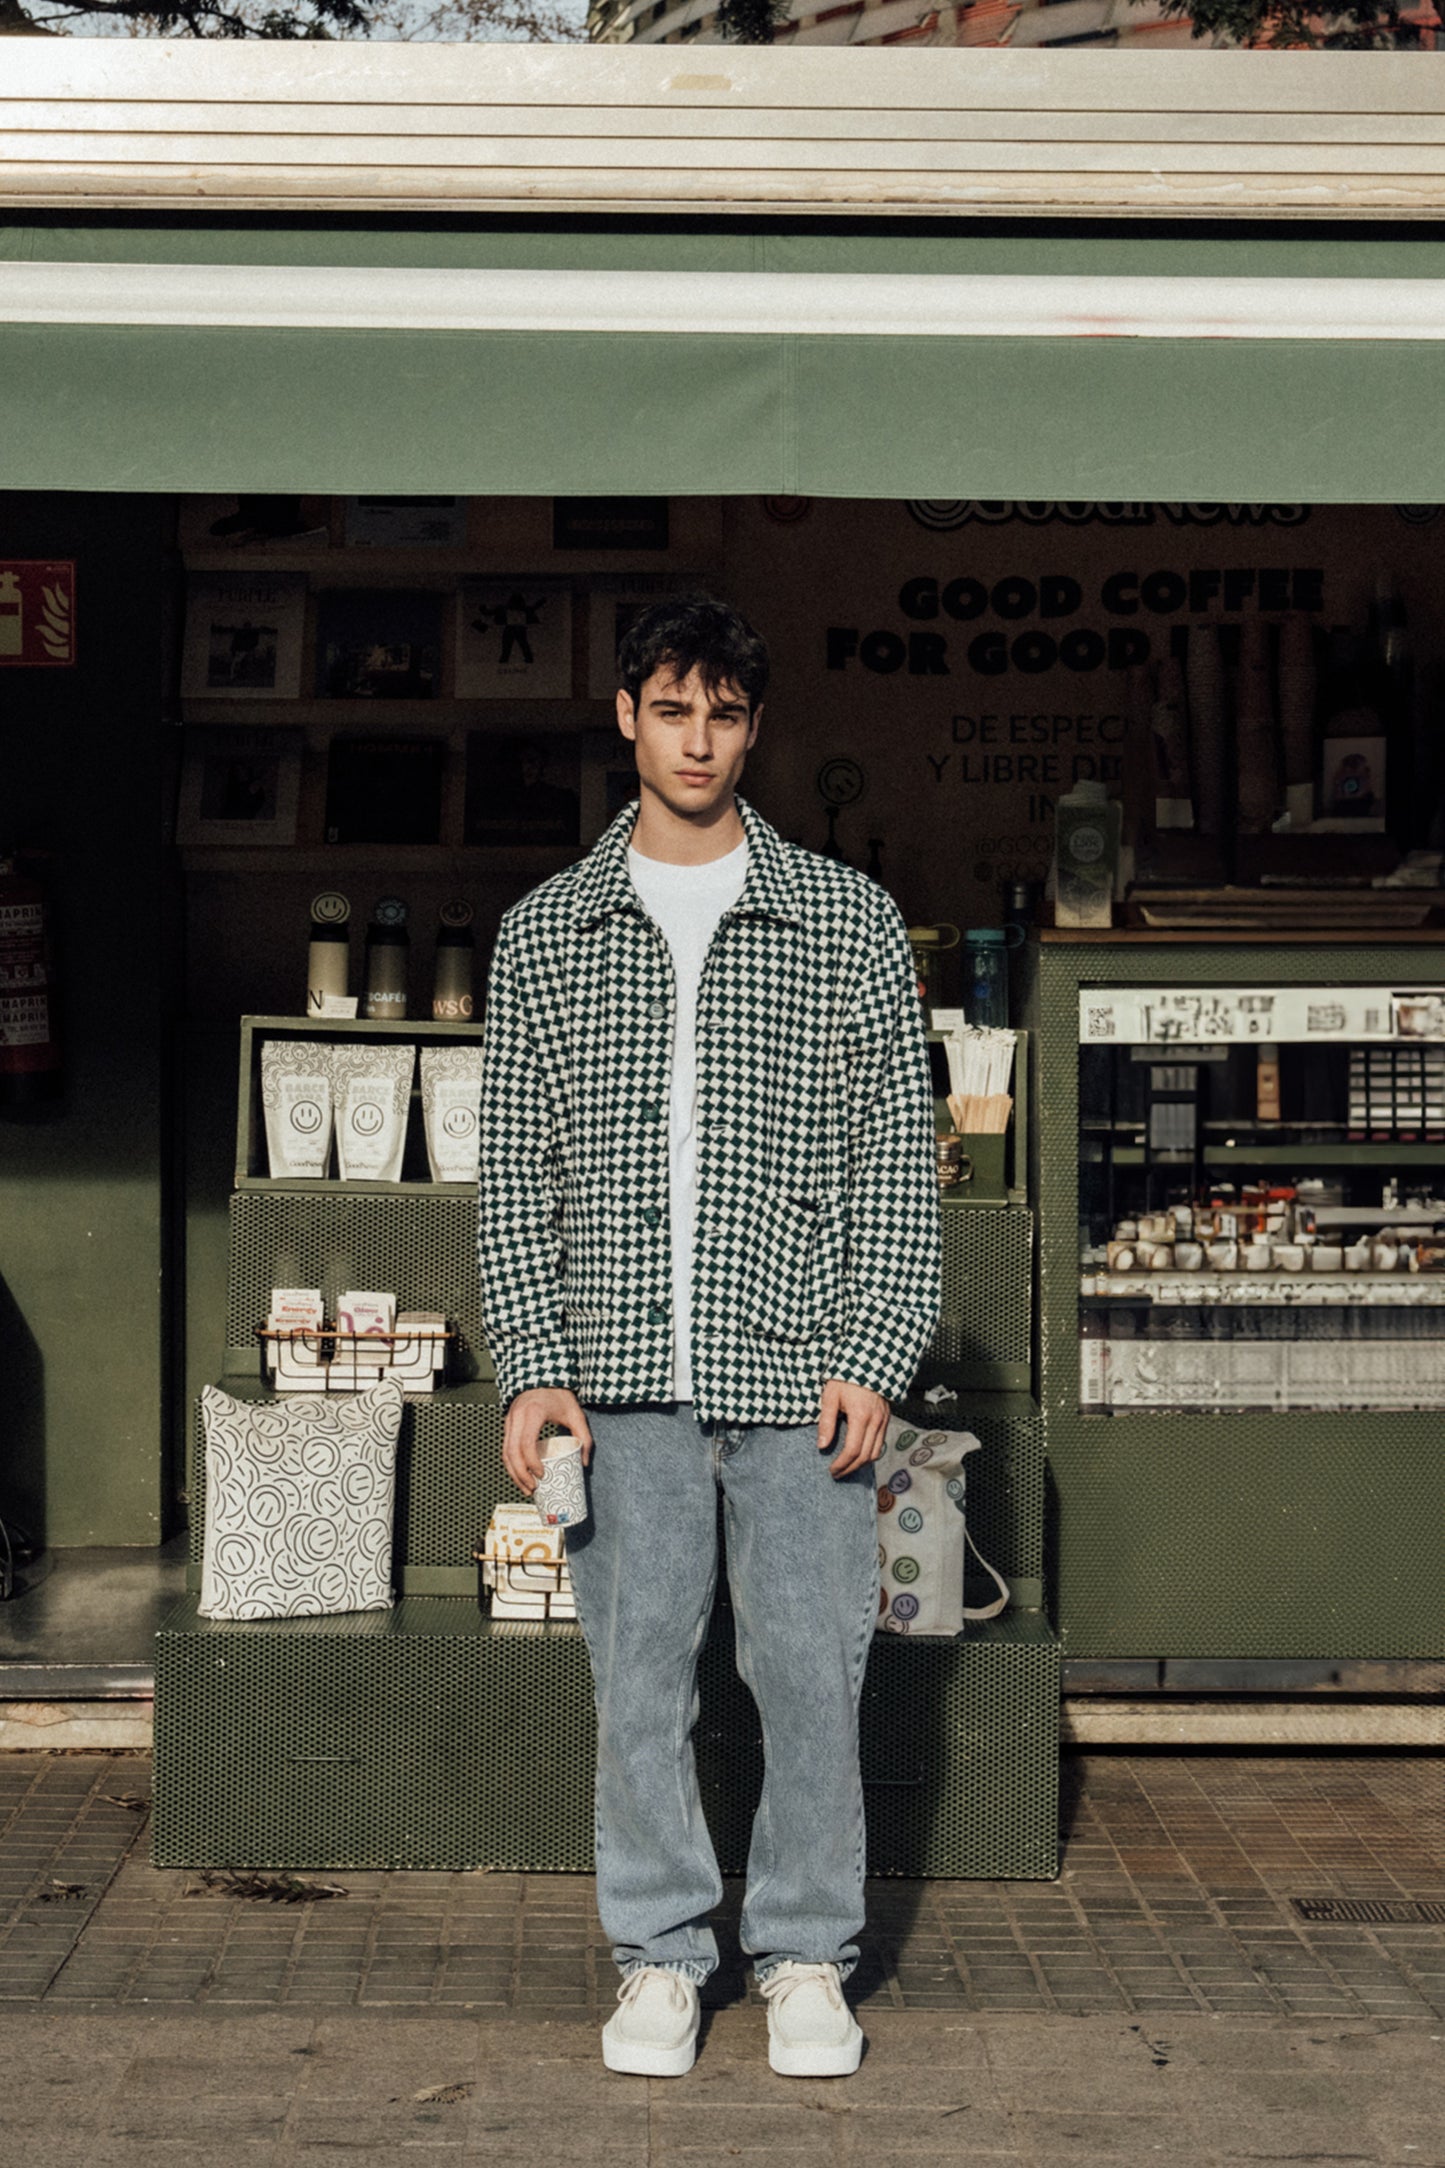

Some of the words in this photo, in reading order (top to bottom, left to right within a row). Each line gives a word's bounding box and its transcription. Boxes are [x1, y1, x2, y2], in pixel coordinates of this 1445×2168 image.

[900, 576, 1082, 620] GOOD
[1102, 569, 1324, 614] COFFEE
[827, 627, 950, 675] FOR
[968, 628, 1150, 674] GOOD
[952, 715, 998, 743] DE
[927, 755, 950, 783] Y
[962, 755, 1060, 783] LIBRE
[281, 1305, 317, 1315] Energy
